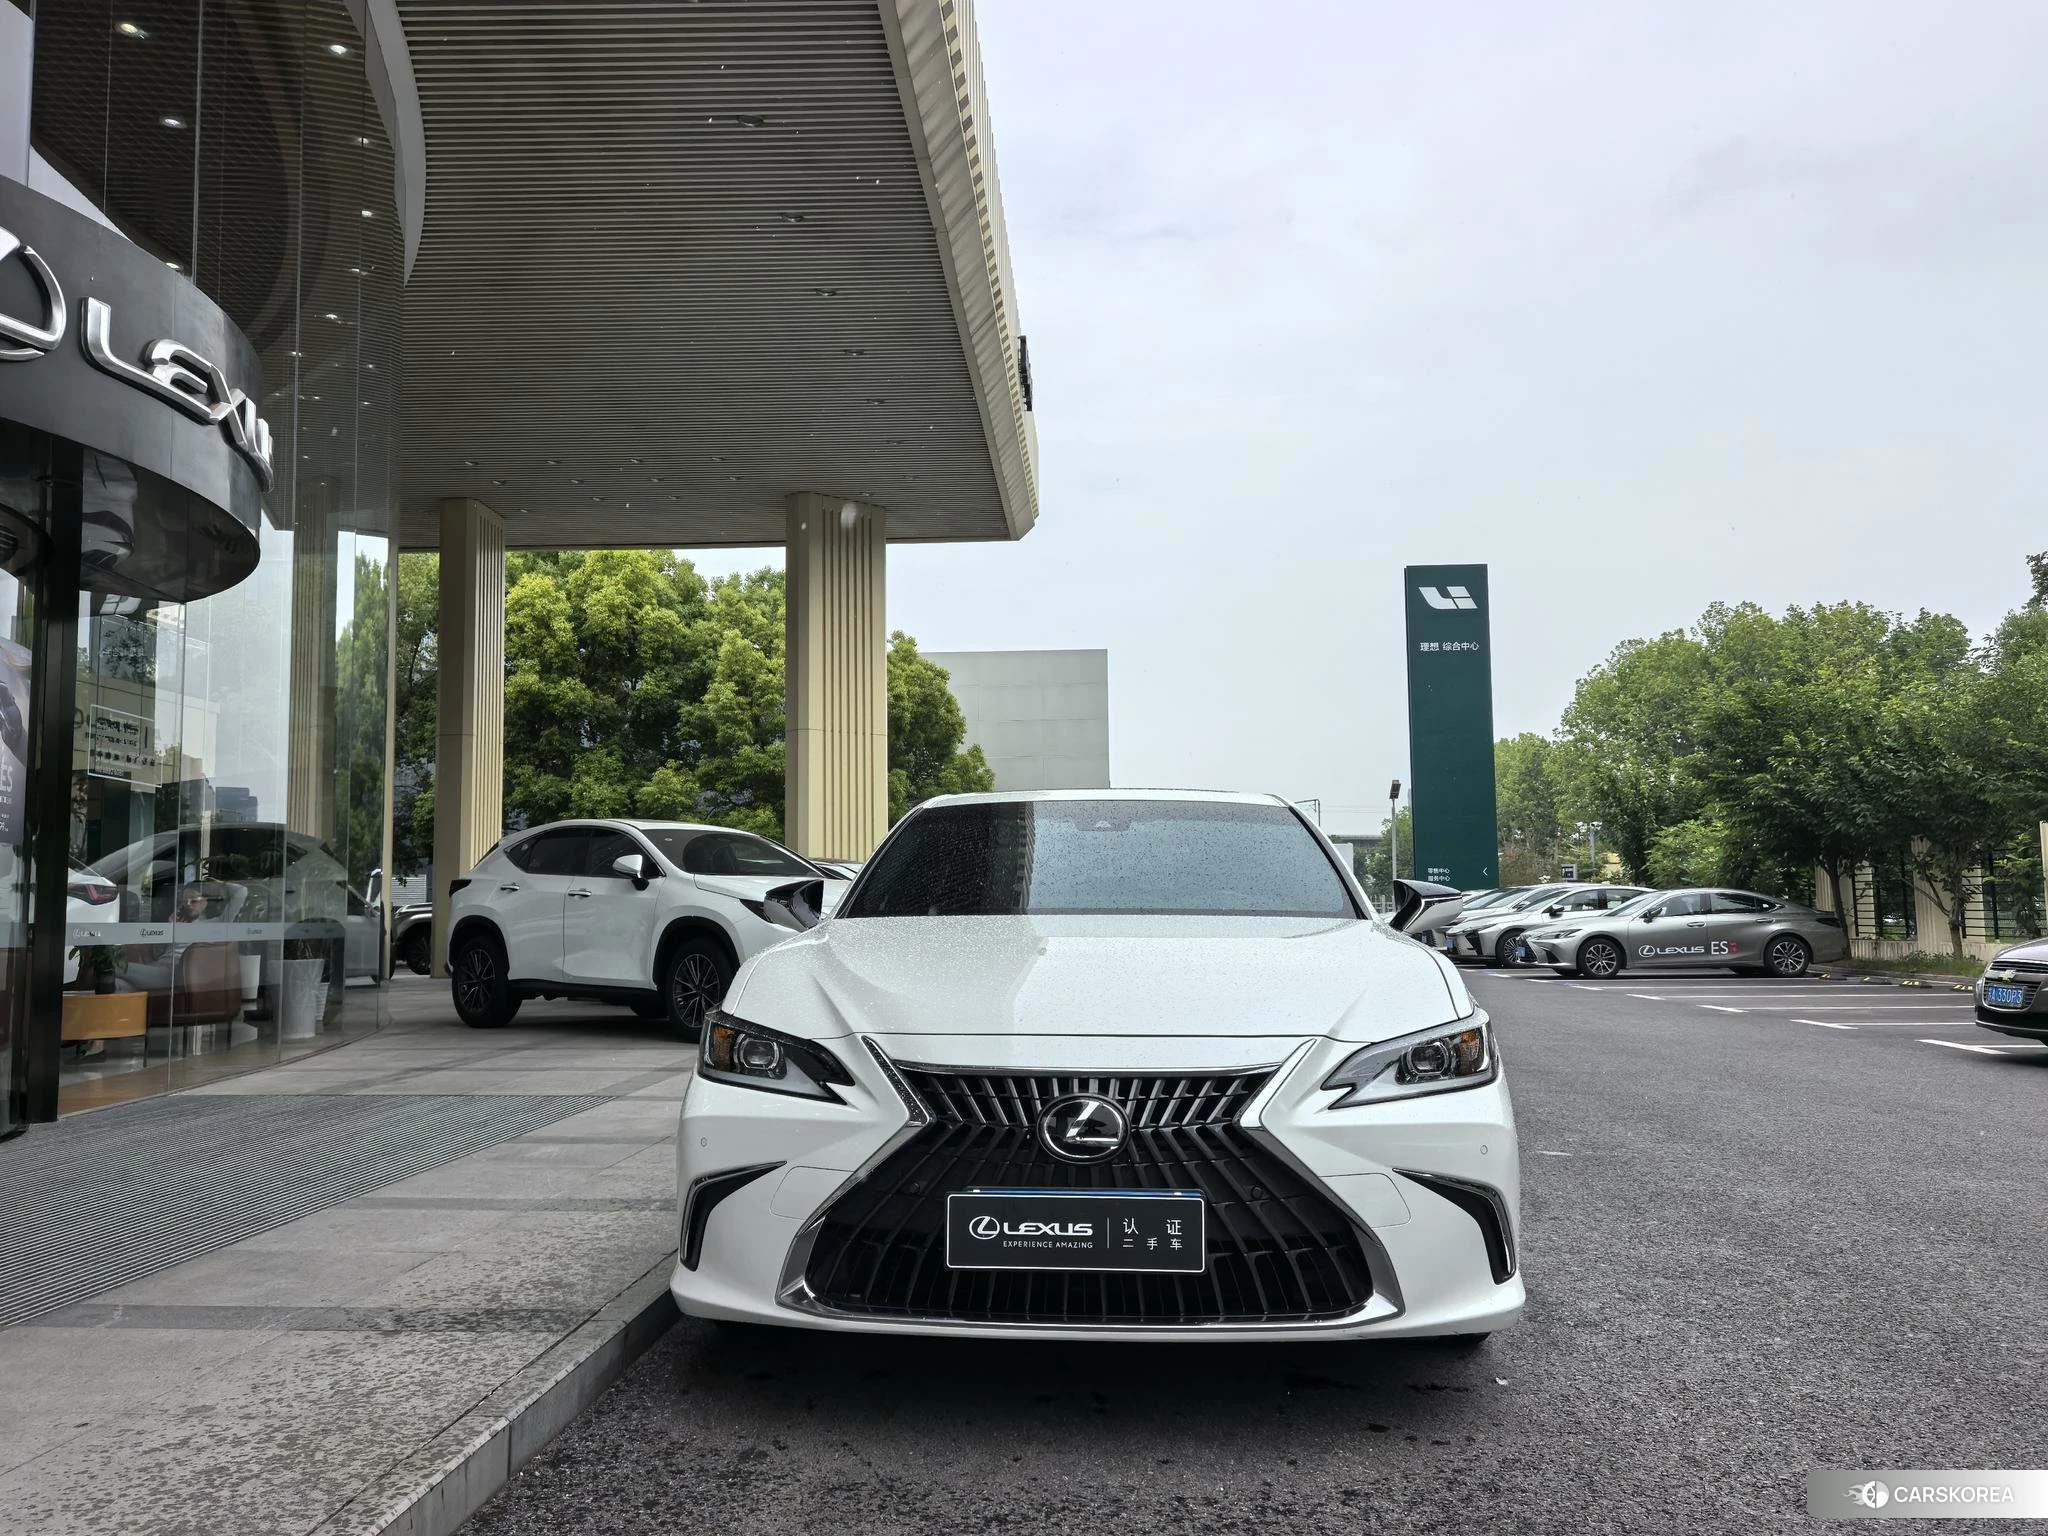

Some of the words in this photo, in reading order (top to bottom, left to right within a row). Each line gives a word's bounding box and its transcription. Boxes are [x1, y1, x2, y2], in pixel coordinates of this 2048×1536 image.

[83, 296, 273, 492] LEXU
[1419, 641, 1440, 652] 理想
[1442, 641, 1480, 652] 综合中心
[1656, 945, 1705, 955] LEXUS
[1003, 1222, 1094, 1237] LEXUS
[1003, 1240, 1053, 1249] EXPERIENCE
[1055, 1241, 1094, 1249] AMAZING
